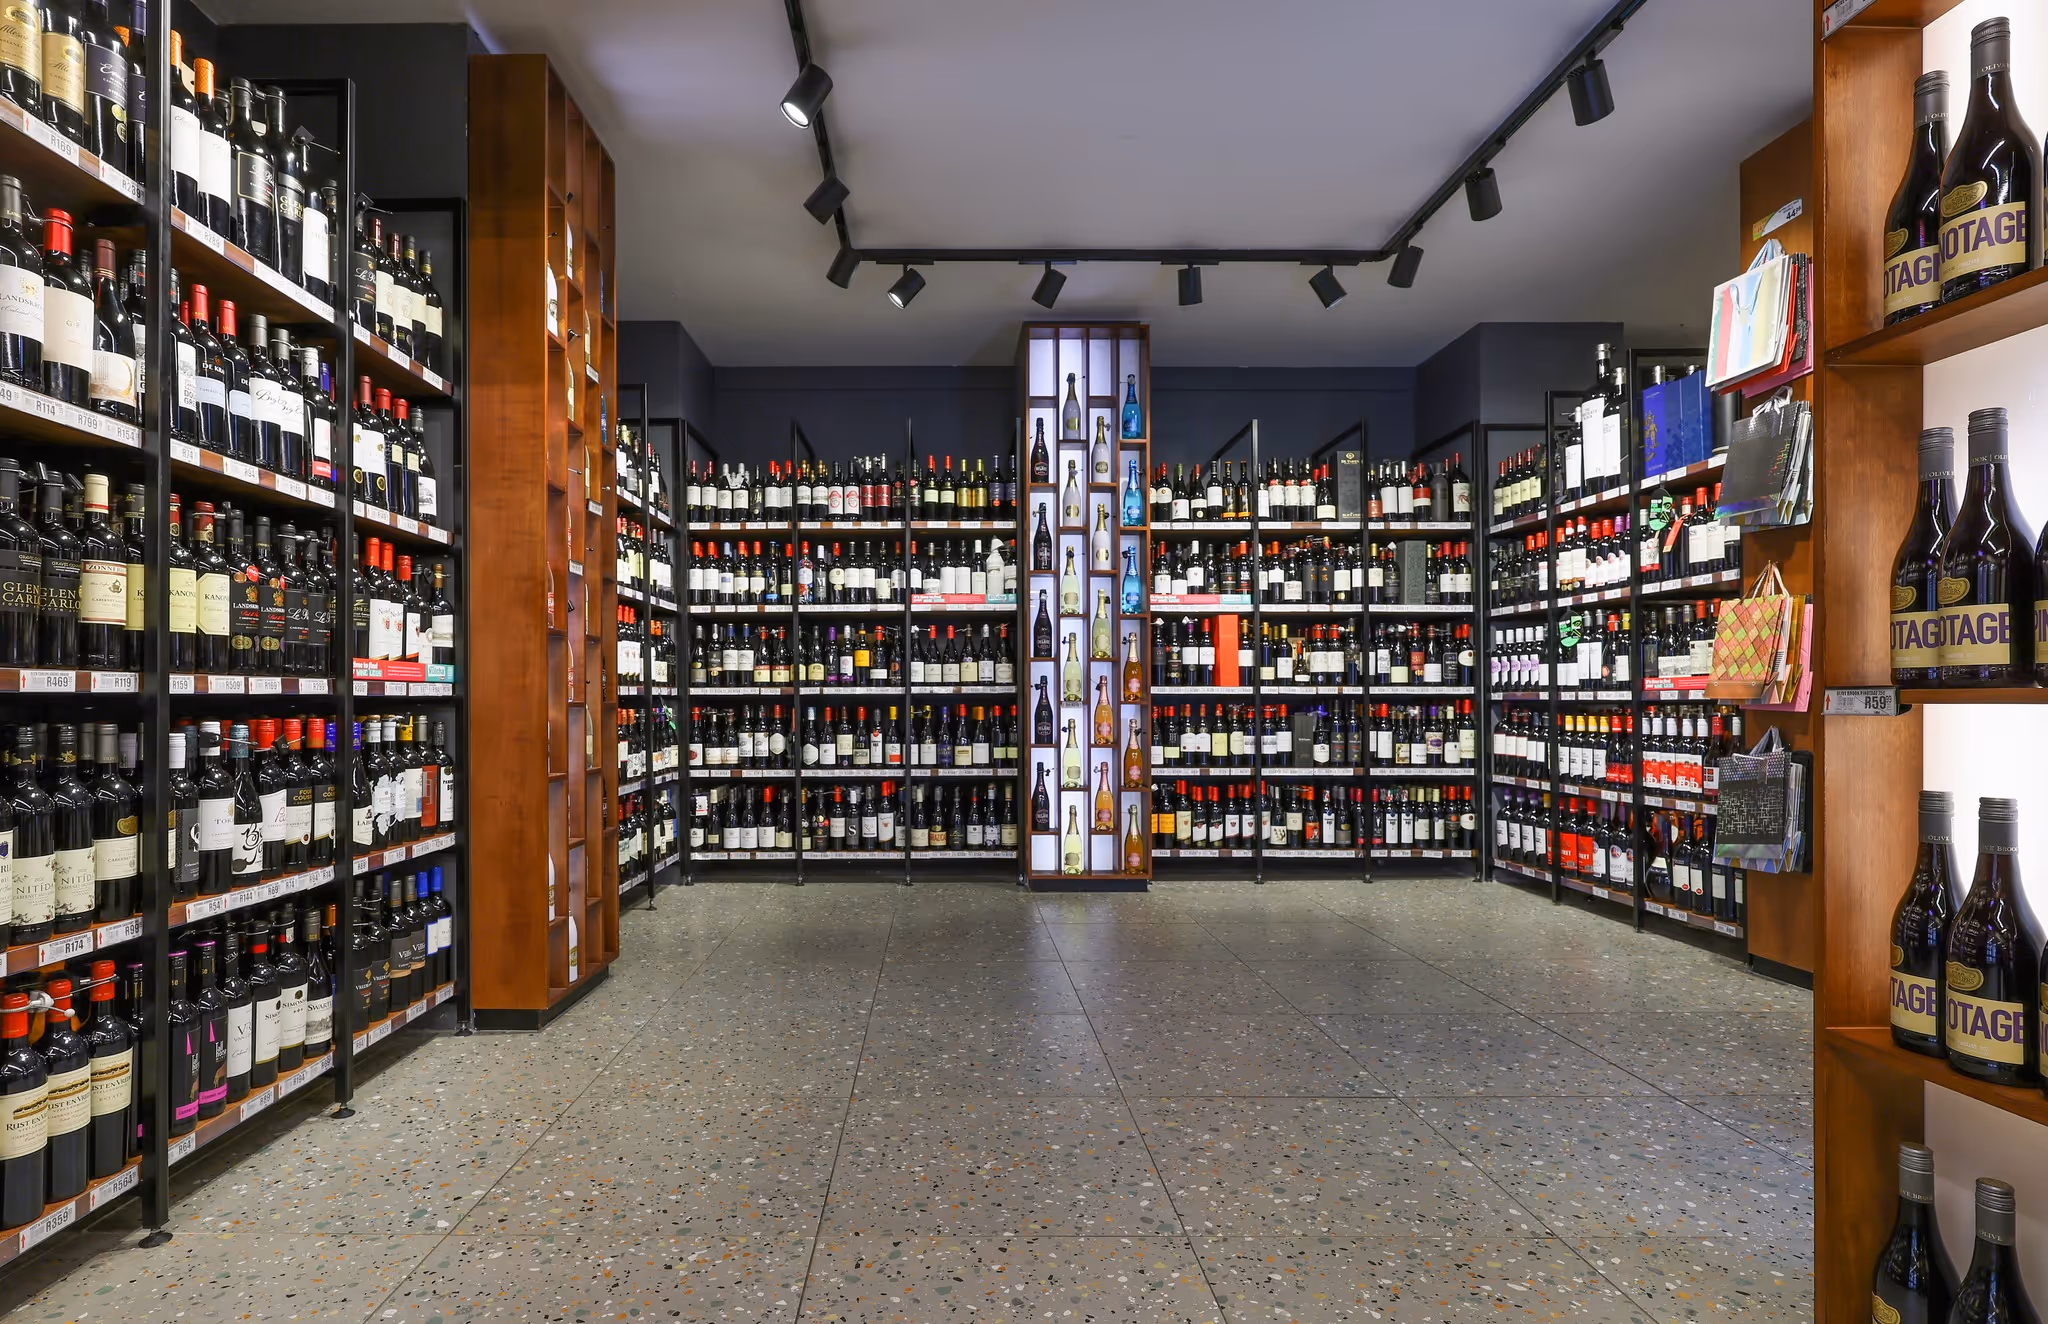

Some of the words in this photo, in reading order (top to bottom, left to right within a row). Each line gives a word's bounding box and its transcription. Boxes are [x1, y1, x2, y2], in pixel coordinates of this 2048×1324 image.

[50, 134, 72, 157] R169
[121, 178, 141, 199] R239
[1786, 209, 1796, 219] 44
[36, 400, 55, 416] R114
[78, 414, 98, 430] R799
[117, 426, 135, 441] R154
[46, 676, 68, 688] R469
[115, 677, 132, 688] R119
[173, 679, 188, 690] R159
[225, 680, 241, 690] R509
[1864, 695, 1886, 709] R59
[1928, 834, 1950, 842] OLIVE
[267, 886, 279, 896] R69
[209, 902, 220, 912] R54
[65, 939, 84, 954] R174
[6, 1120, 29, 1131] RUST
[178, 1140, 191, 1154] R64
[112, 1175, 133, 1193] R564
[46, 1211, 68, 1232] R359
